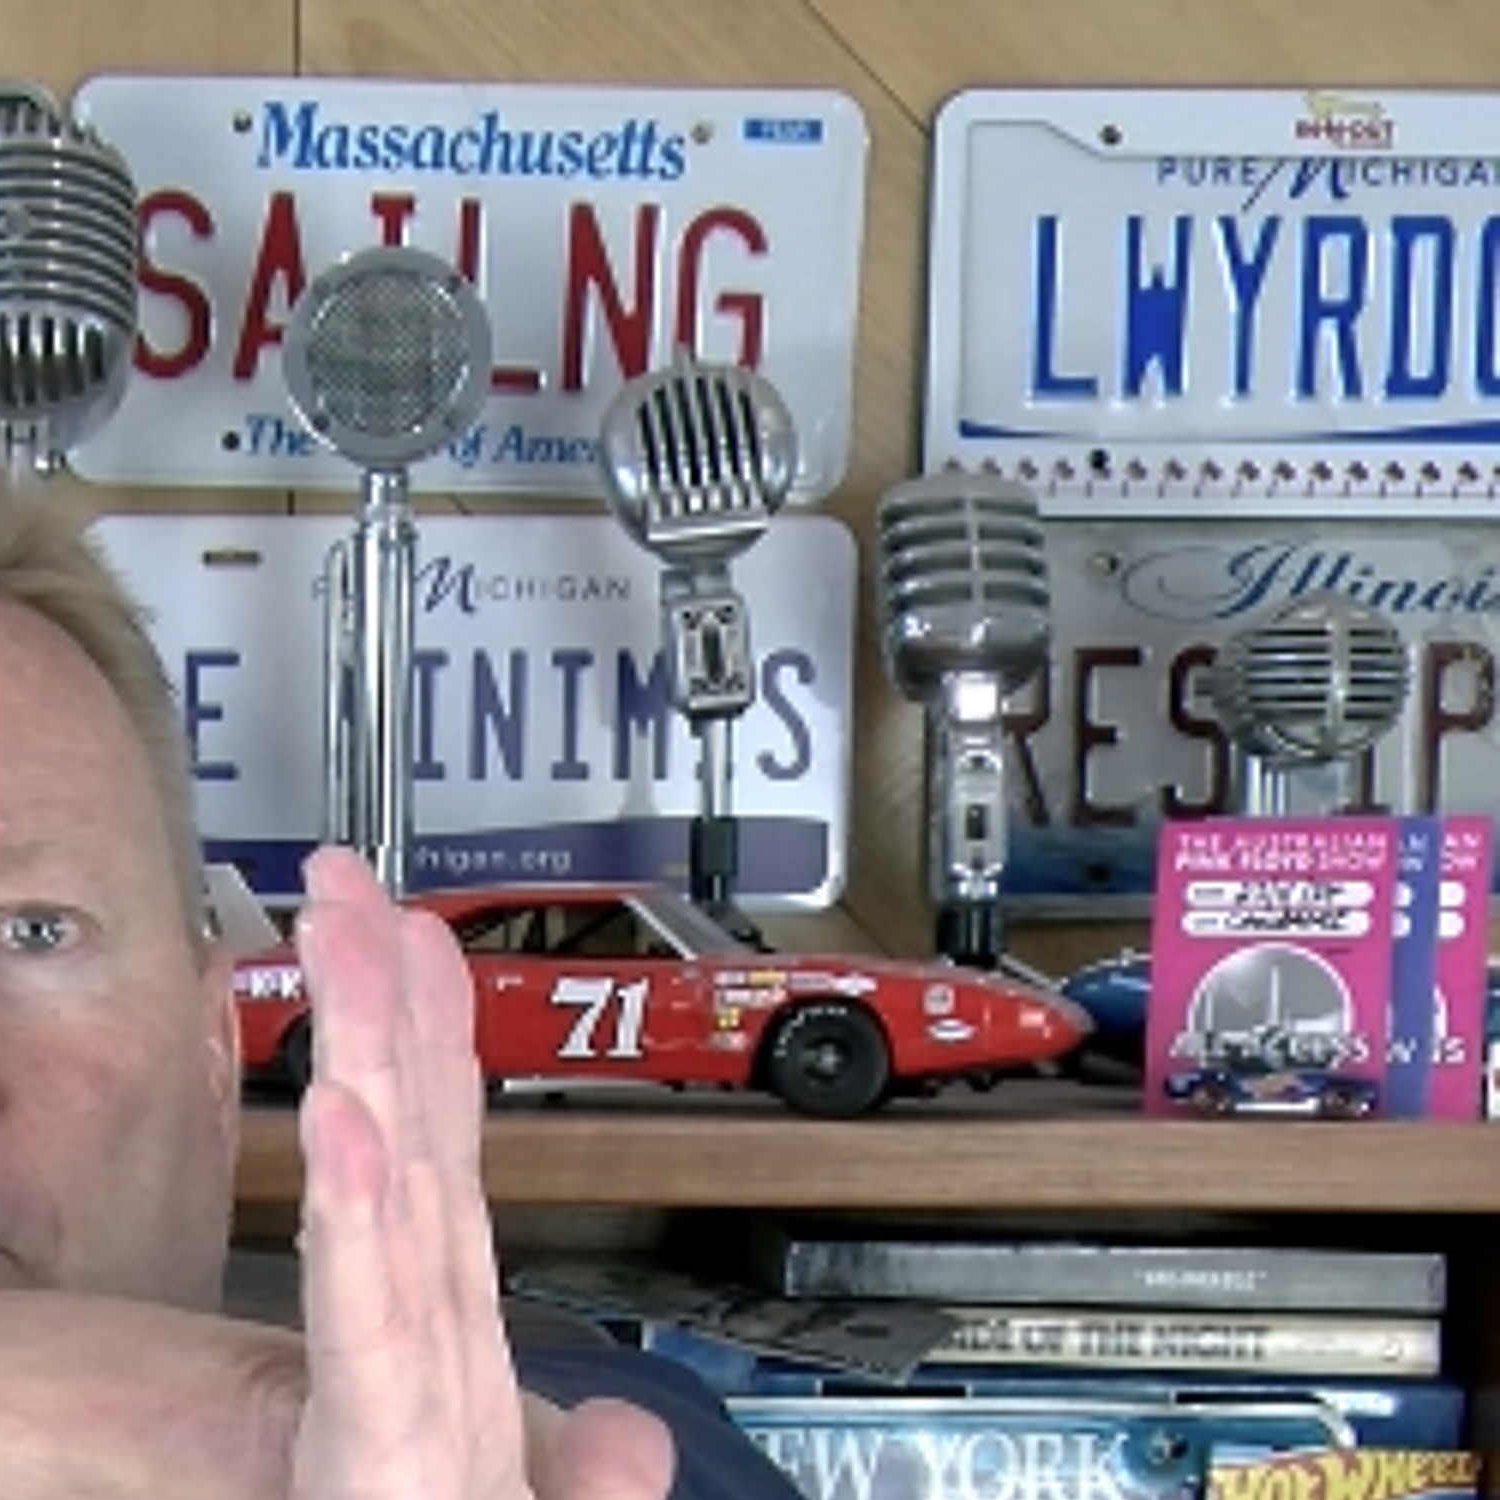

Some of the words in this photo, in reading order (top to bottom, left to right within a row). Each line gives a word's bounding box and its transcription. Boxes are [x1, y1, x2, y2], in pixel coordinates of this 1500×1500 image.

[257, 102, 687, 180] Massachusetts
[1157, 157, 1257, 186] PURE
[1130, 535, 1500, 622] Illinoi
[408, 651, 817, 781] INIMS
[550, 977, 648, 1058] 71
[1078, 1318, 1143, 1357] THE
[1150, 1322, 1270, 1360] NIGHT
